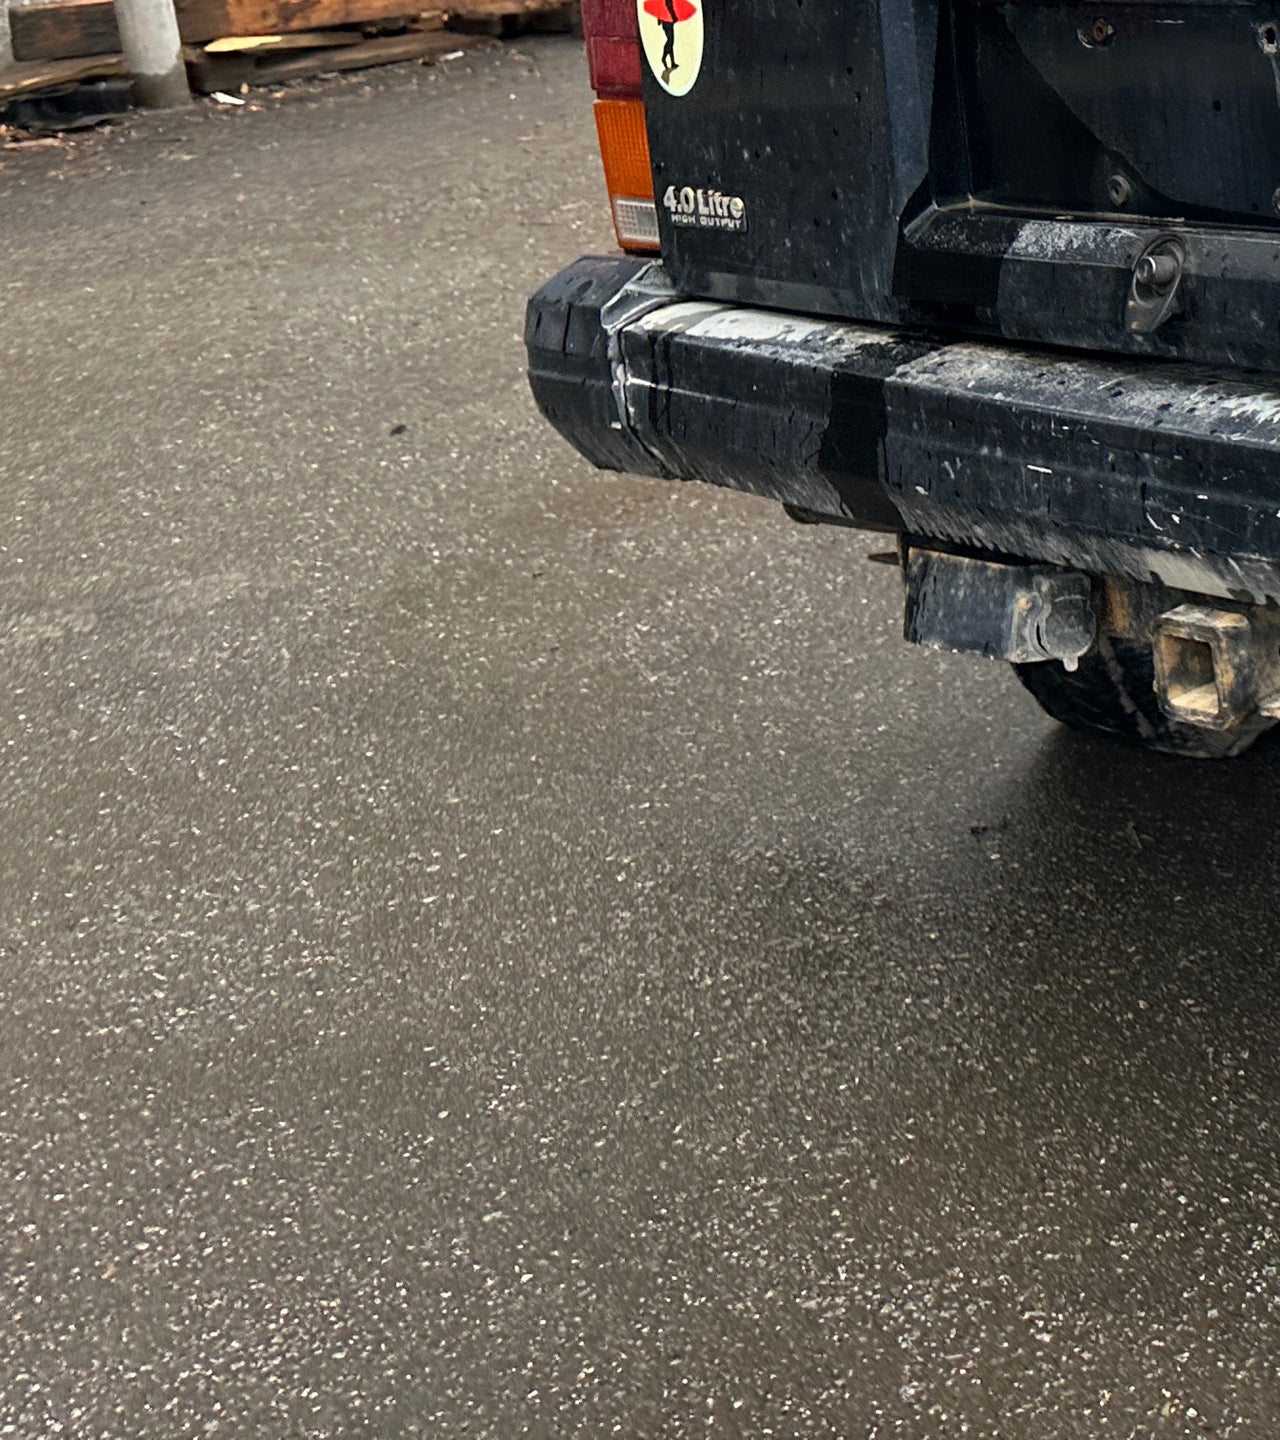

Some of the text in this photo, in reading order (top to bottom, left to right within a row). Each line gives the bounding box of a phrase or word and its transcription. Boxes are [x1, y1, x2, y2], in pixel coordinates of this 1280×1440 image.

[663, 185, 745, 219] 4.0 Litre
[671, 214, 742, 229] HIGH OUTPUT
